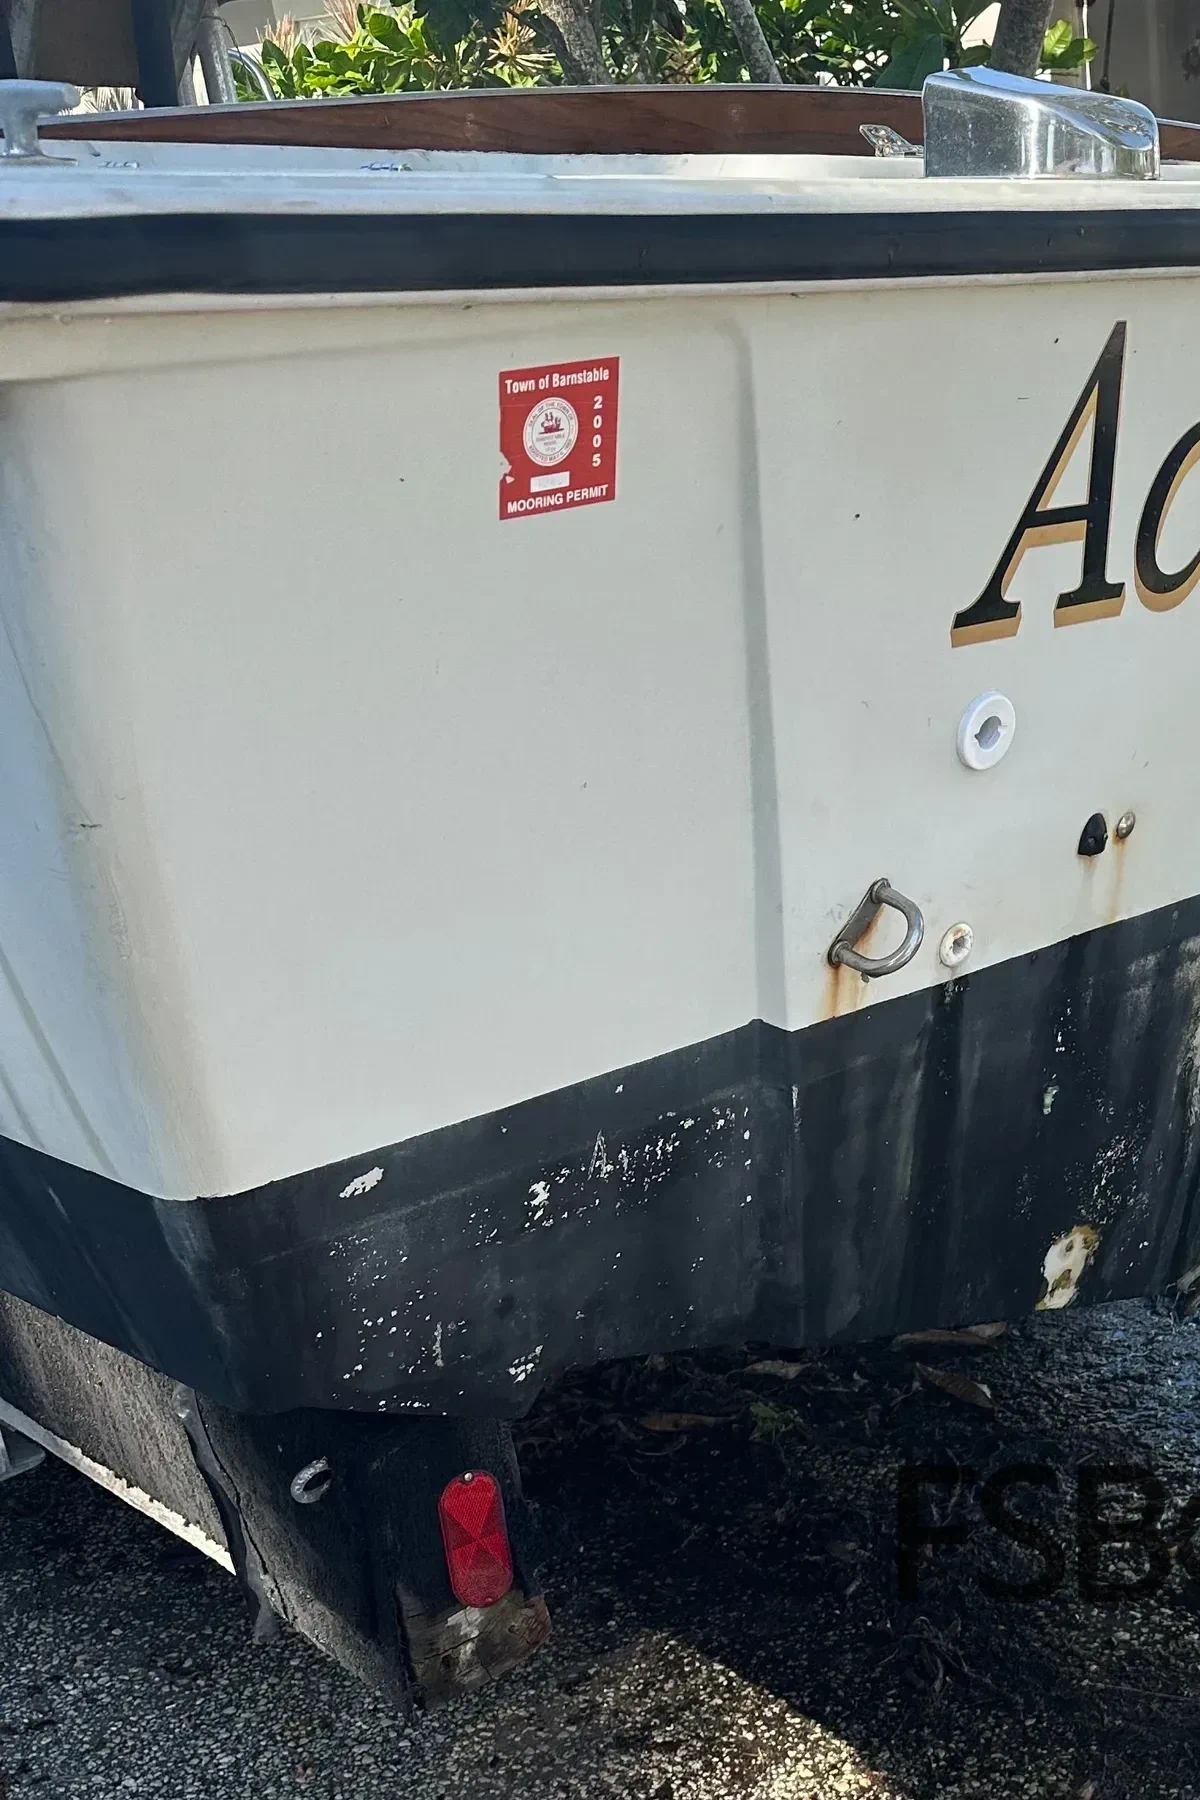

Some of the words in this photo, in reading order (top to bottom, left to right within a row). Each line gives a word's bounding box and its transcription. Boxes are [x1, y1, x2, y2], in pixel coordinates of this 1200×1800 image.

[505, 379, 535, 394] Town
[538, 375, 550, 390] of
[552, 367, 609, 388] Barnstable
[507, 493, 563, 513] MOORING
[566, 484, 608, 502] PERMIT
